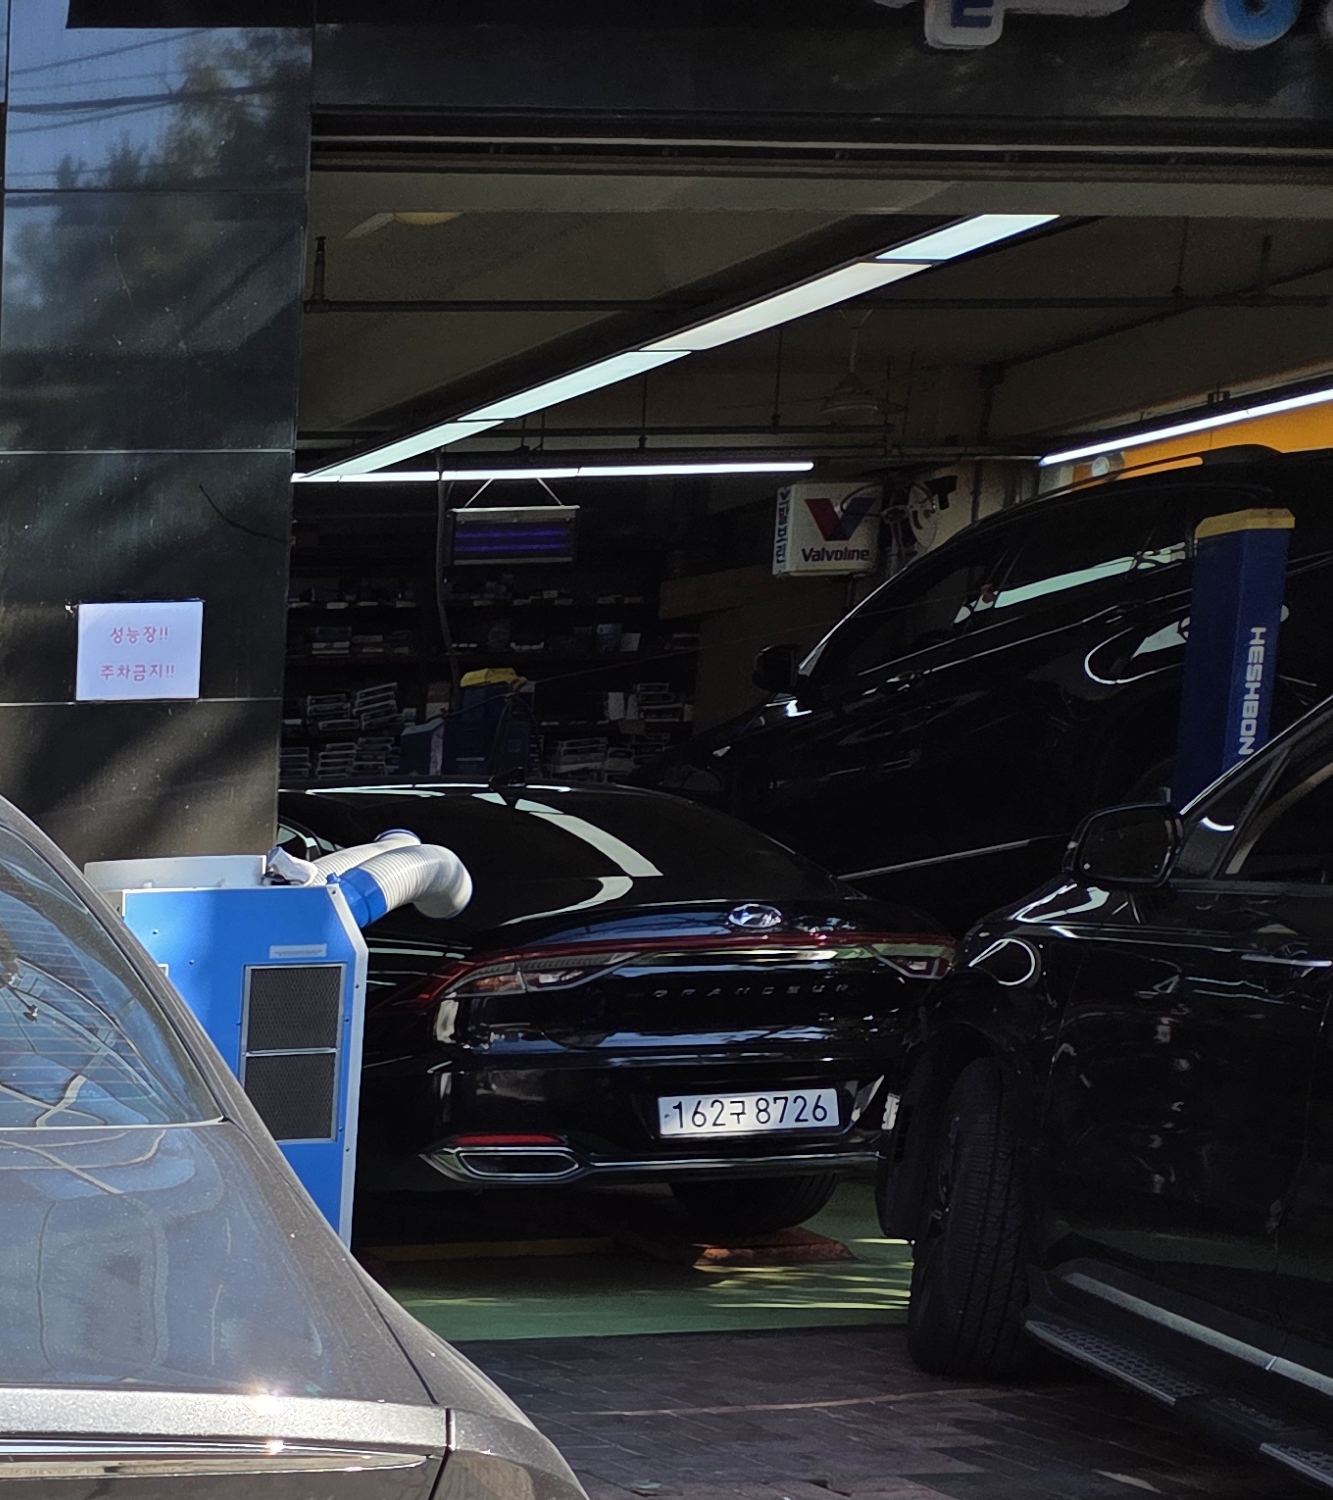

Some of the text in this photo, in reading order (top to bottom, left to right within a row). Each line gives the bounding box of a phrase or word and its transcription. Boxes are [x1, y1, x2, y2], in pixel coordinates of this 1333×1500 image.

[801, 546, 870, 562] Valvoline
[110, 626, 169, 645] 성능장!!
[100, 664, 175, 682] 주차금지!!
[1238, 627, 1267, 755] HESHBON
[672, 1094, 828, 1129] 162구 8726
